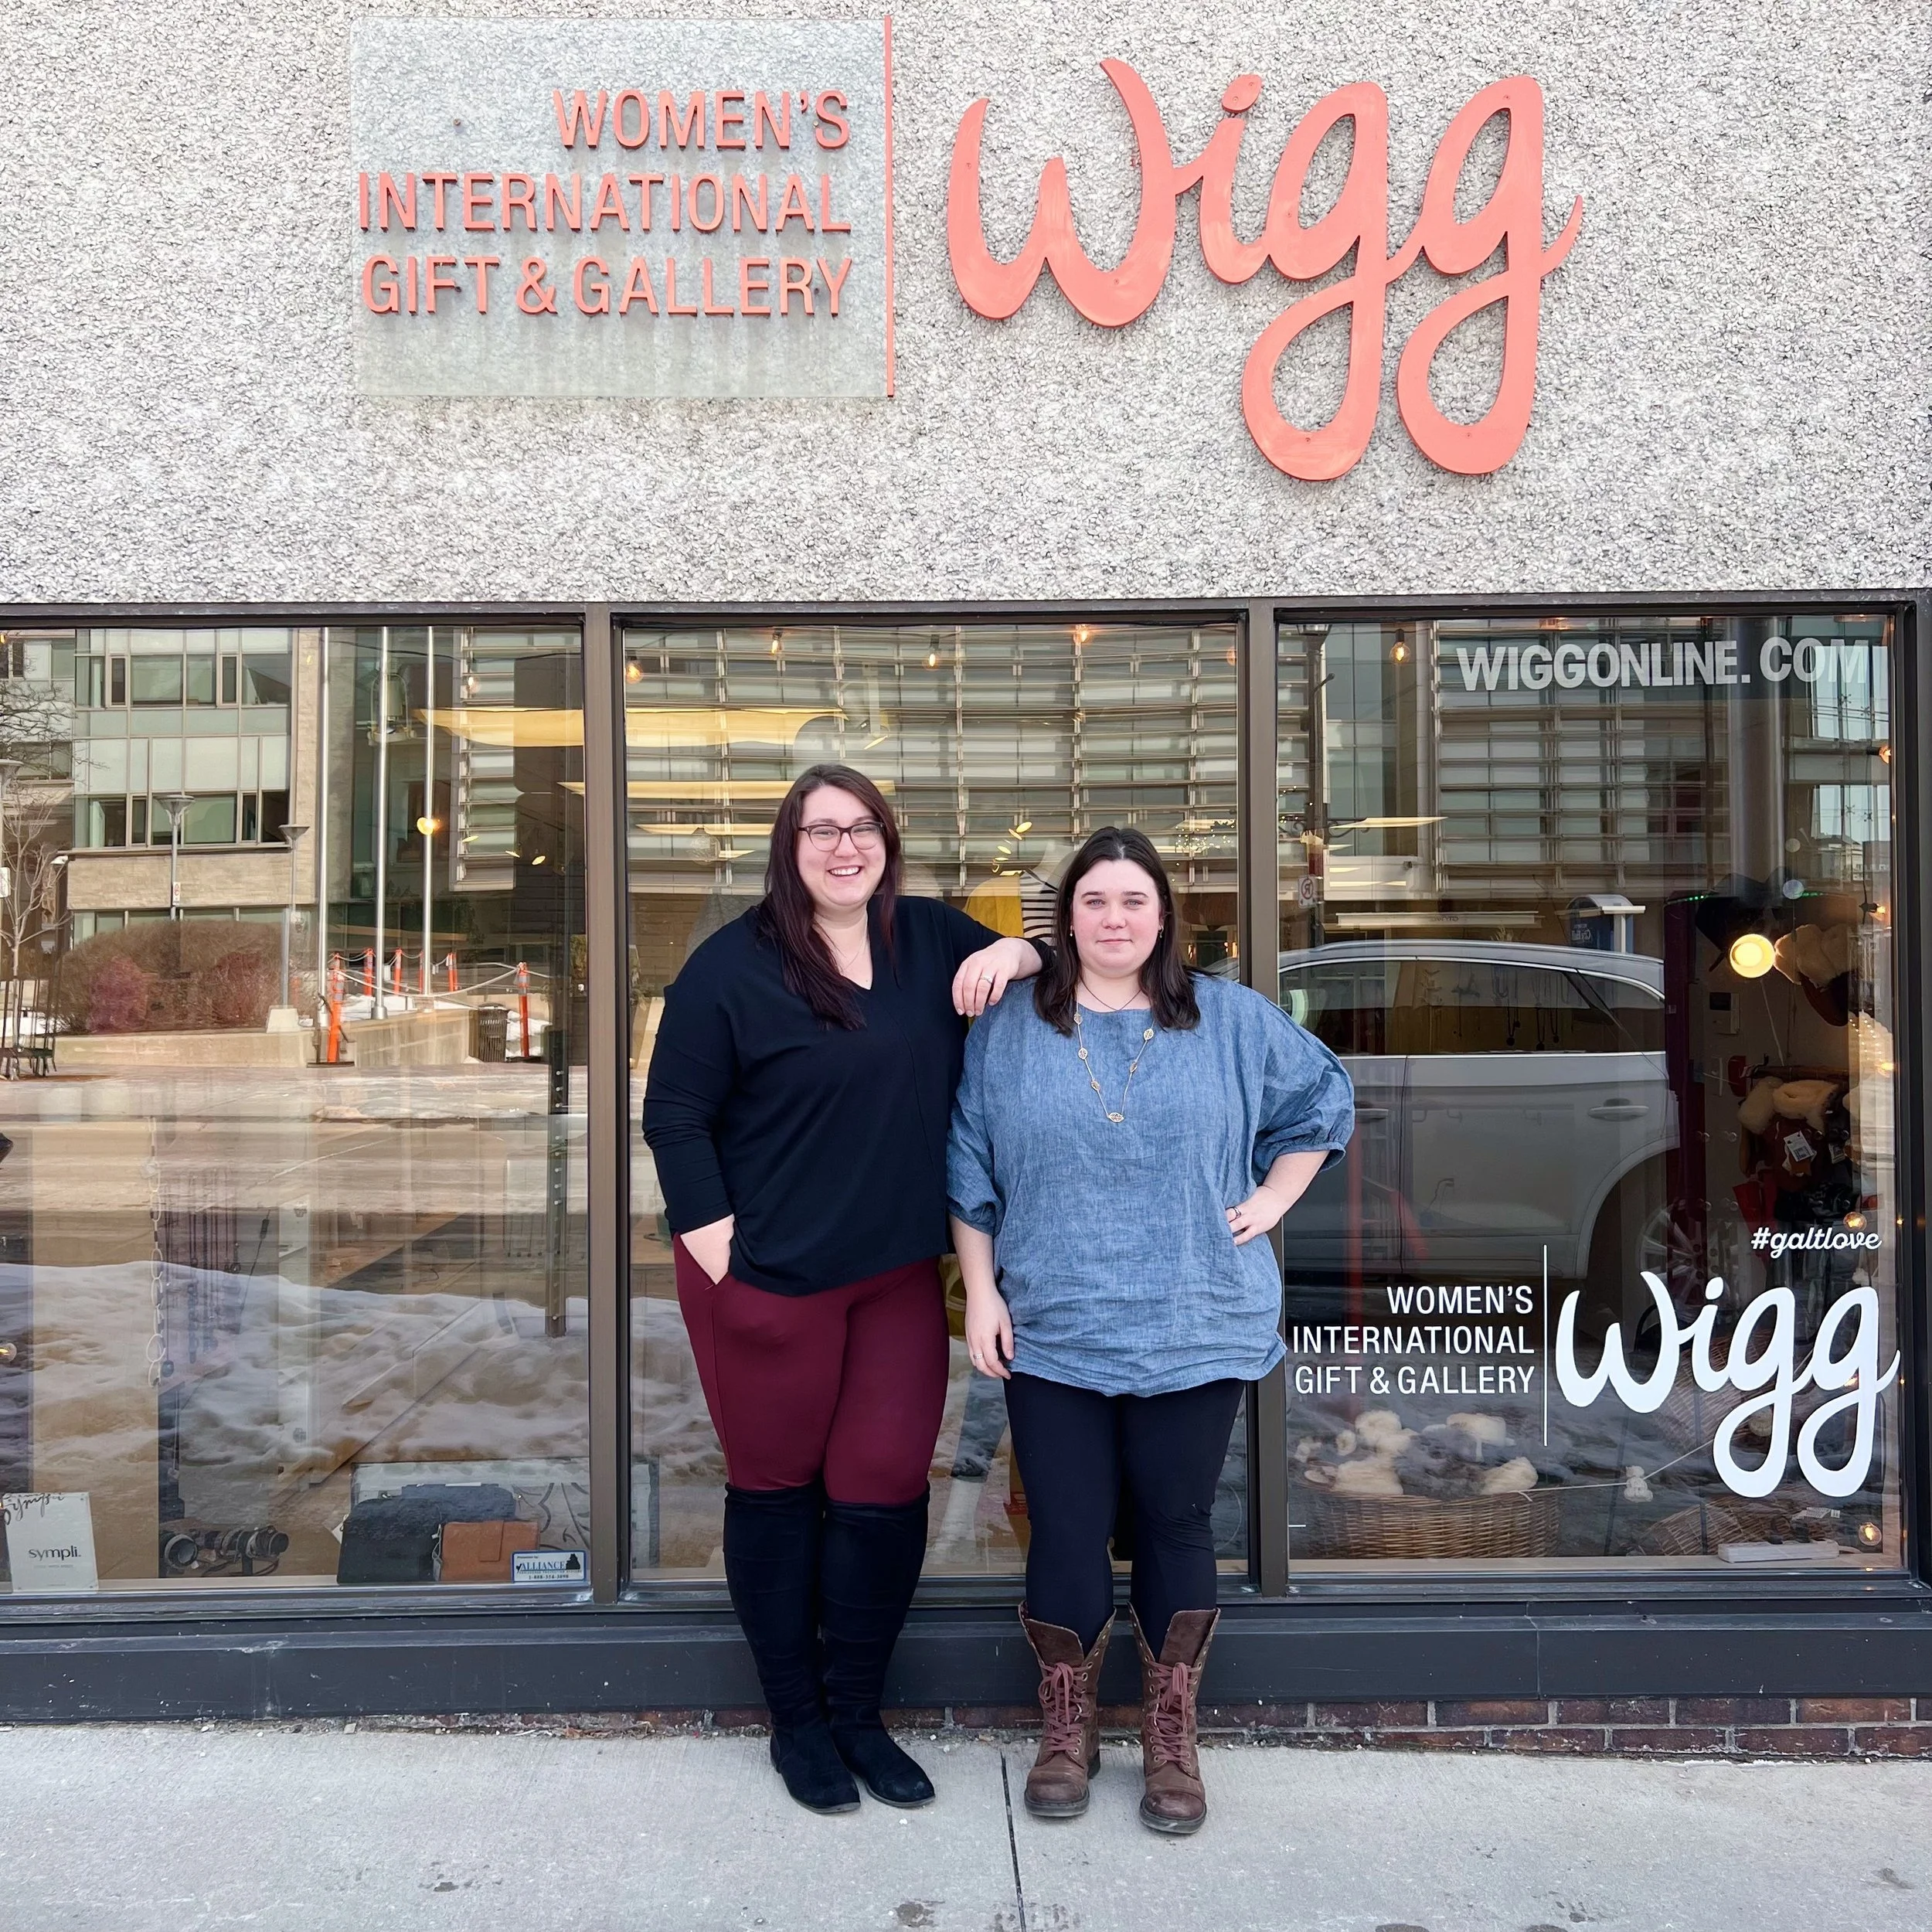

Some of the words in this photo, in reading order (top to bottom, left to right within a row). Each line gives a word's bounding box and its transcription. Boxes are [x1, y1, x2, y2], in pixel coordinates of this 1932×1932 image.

[553, 90, 849, 148] WOMEN'S
[359, 172, 851, 231] INTERNATIONAL
[362, 255, 499, 315] GIFT
[515, 257, 556, 315] &
[573, 257, 852, 316] GALLERY
[1456, 640, 1751, 692] WIGGONLINE.
[1759, 636, 1869, 684] COM
[1750, 1226, 1883, 1259] #galtlove
[1386, 1285, 1534, 1315] WOMEN'S
[1293, 1325, 1535, 1355] INTERNATIONAL
[1294, 1366, 1362, 1395] GIFT
[1369, 1366, 1391, 1395] &
[1397, 1366, 1535, 1395] GALLERY
[29, 1546, 82, 1561] sympli.
[520, 1561, 565, 1570] ALLIANCE
